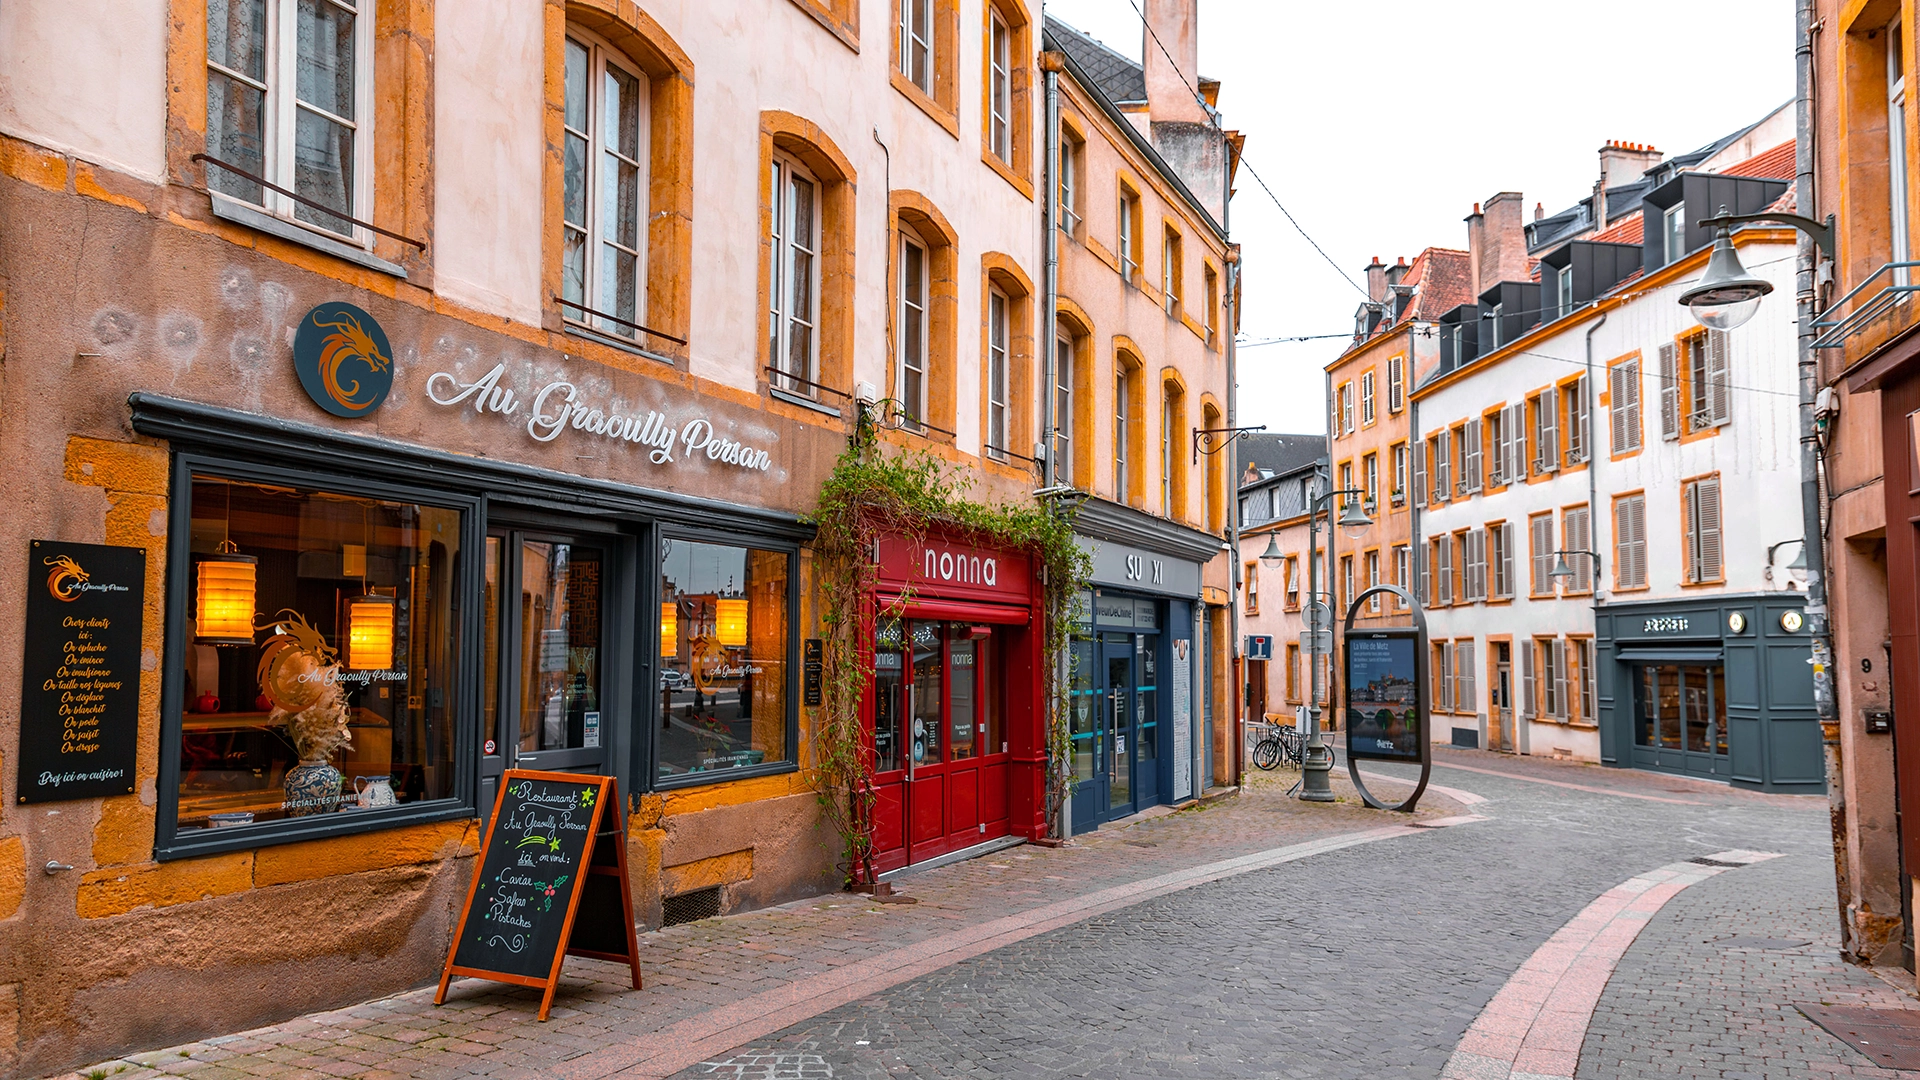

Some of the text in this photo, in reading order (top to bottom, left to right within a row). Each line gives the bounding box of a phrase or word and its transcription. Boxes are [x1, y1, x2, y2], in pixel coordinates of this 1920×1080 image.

[427, 363, 772, 472] Au Graoully Persan
[925, 548, 996, 586] nonna
[1126, 554, 1163, 585] SU XI
[63, 640, 76, 653] On
[65, 653, 79, 666] On
[951, 654, 973, 665] nonna
[1861, 658, 1872, 673] 9
[56, 666, 70, 678] On
[297, 666, 408, 687] Au Graoully Persan
[43, 679, 57, 691] On
[61, 691, 75, 703] On
[58, 704, 73, 716] On
[64, 716, 78, 728] On
[62, 729, 77, 741] On
[61, 741, 76, 754] On
[38, 771, 62, 787] Bref
[62, 772, 76, 783] ici
[517, 780, 578, 803] Restaurant
[281, 796, 331, 809] SPÉCIALITÉS
[503, 811, 522, 830] Au
[500, 867, 533, 886] Caviar
[494, 885, 527, 913] Safran
[489, 902, 532, 928] Pistaches
